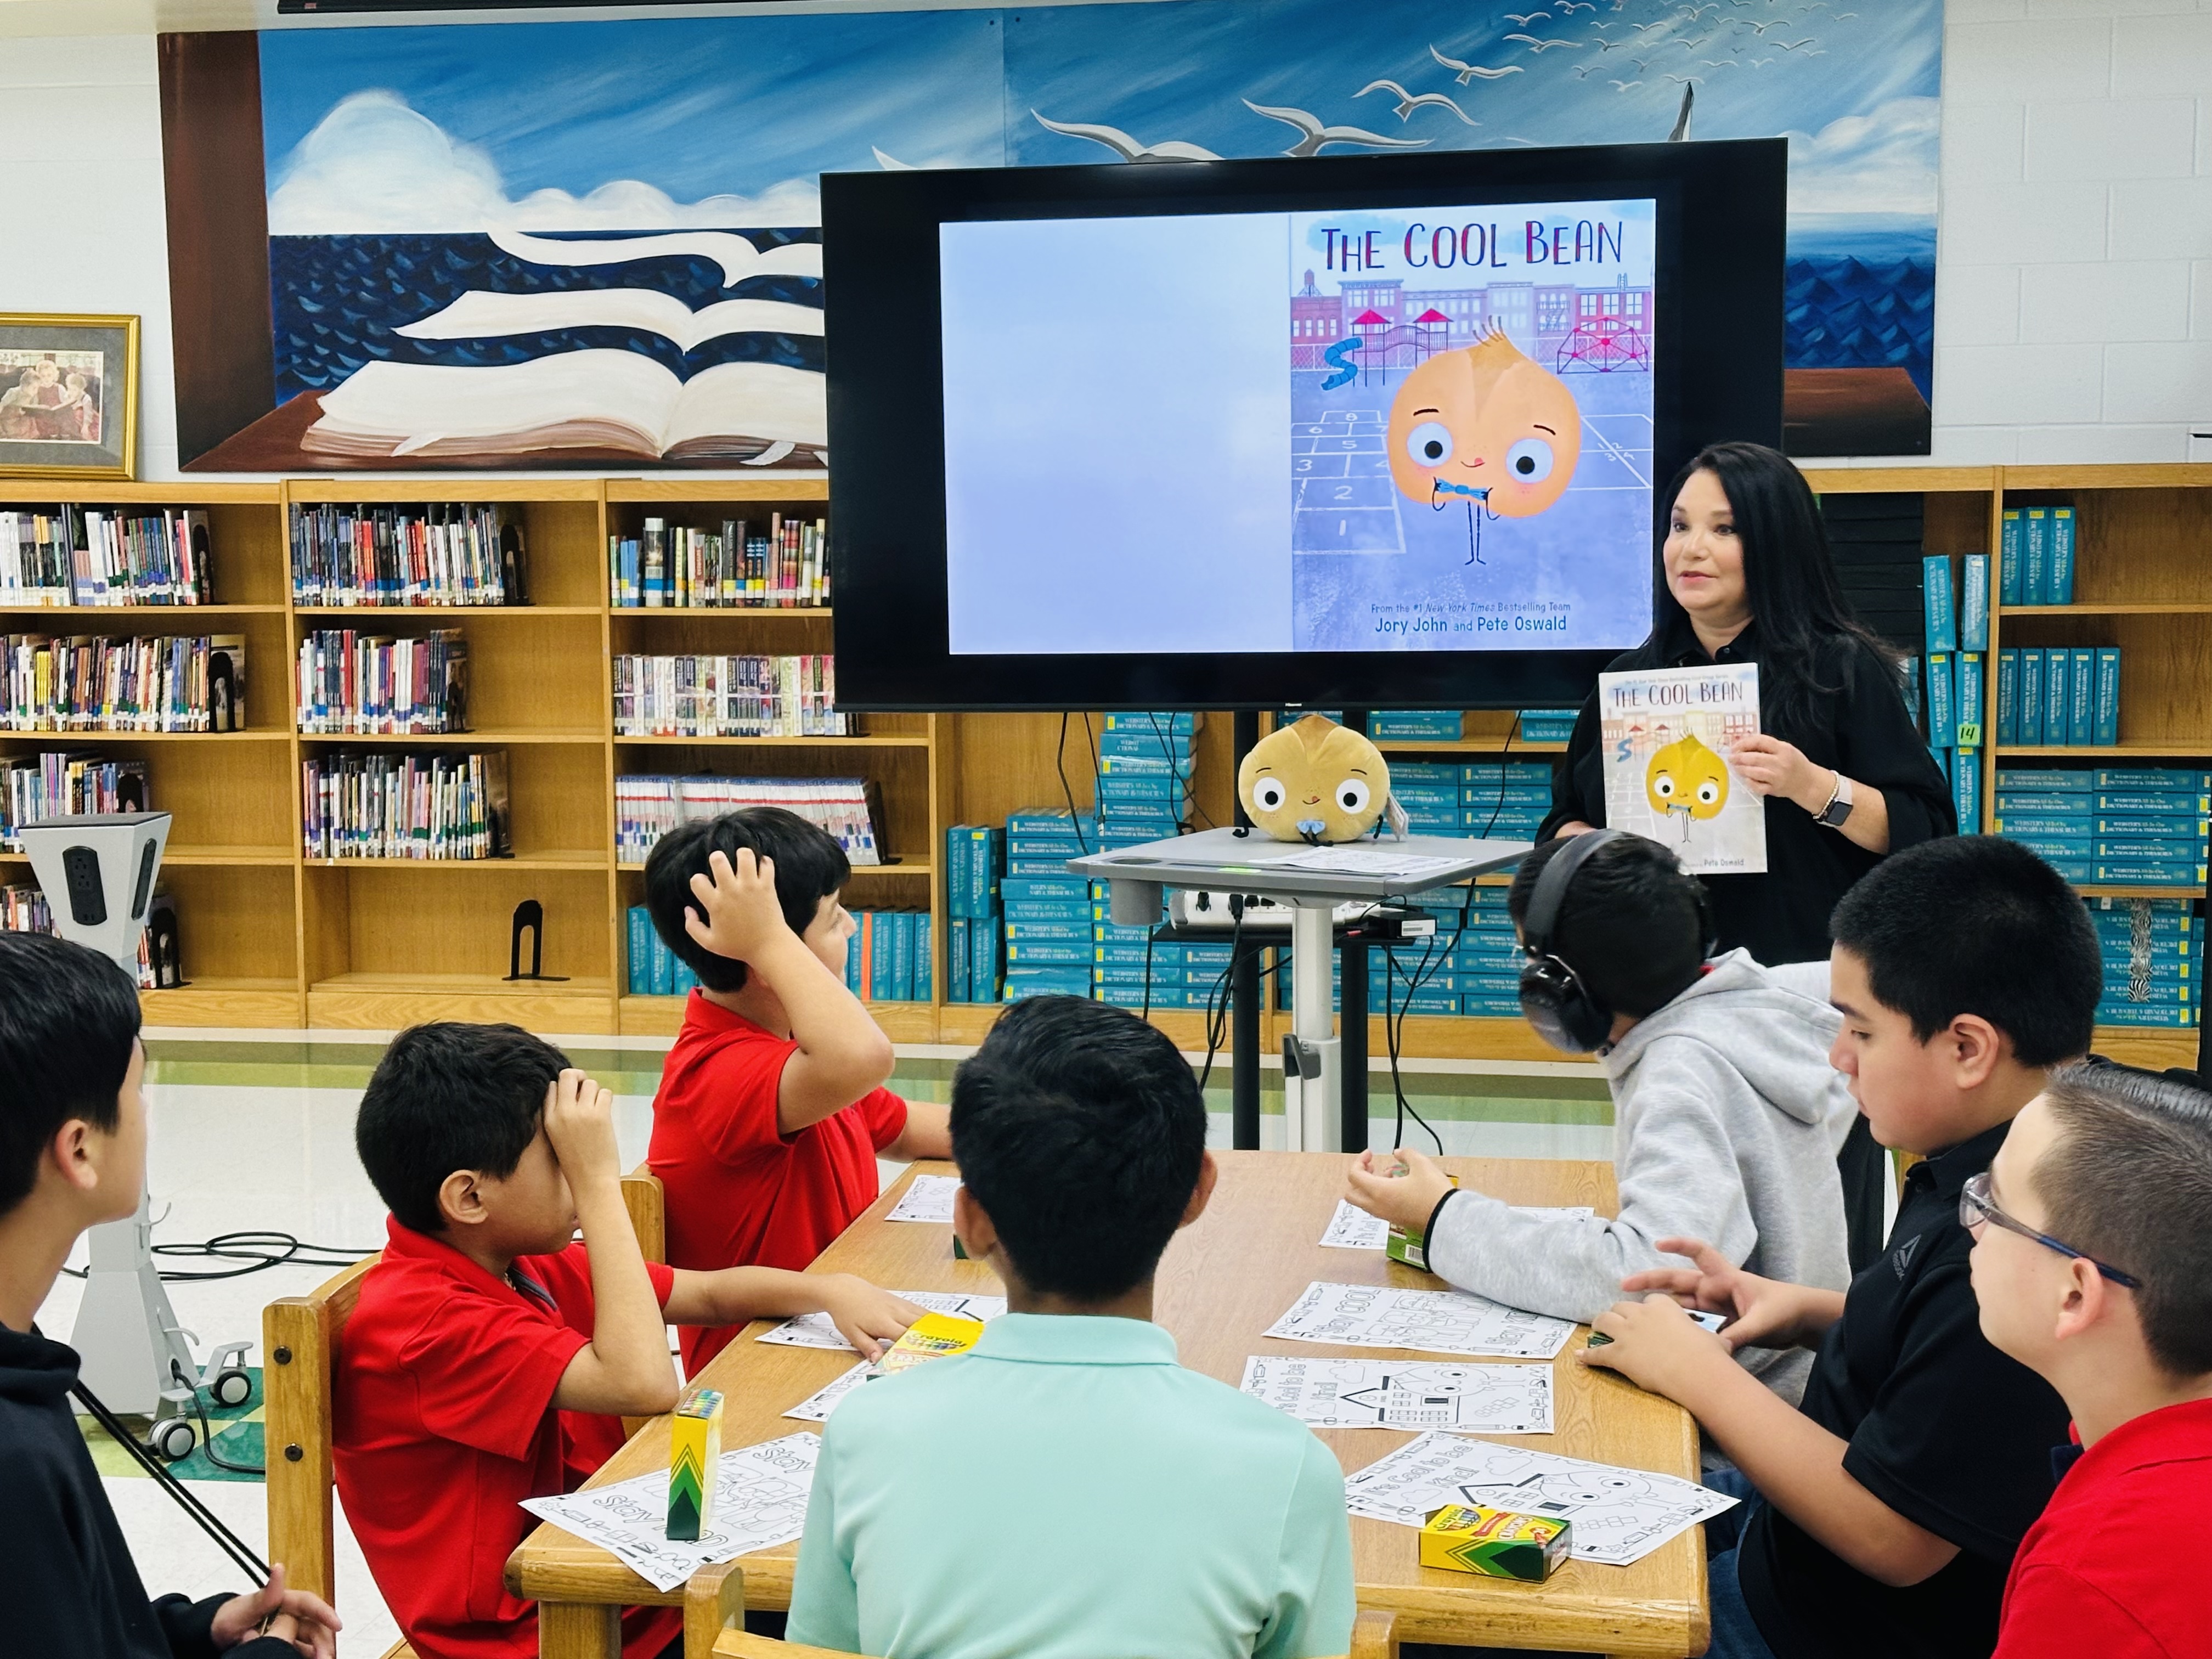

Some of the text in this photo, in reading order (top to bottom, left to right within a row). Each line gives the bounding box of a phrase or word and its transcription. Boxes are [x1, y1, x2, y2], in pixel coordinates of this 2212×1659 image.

[1321, 220, 1622, 272] THE COOL BEAN
[1345, 413, 1358, 421] 8
[1342, 440, 1357, 449] 5
[1296, 459, 1312, 471] 3
[1334, 486, 1352, 500] 2
[1339, 520, 1346, 536] 1
[1372, 602, 1571, 613] From the #1 New York Times Bestselling Team
[1375, 616, 1567, 635] Jory John and Pete Oswald
[1613, 681, 1742, 708] THE COOL BEAN
[1960, 727, 1976, 740] 14
[1313, 1289, 1381, 1334] Stay COOL
[912, 1333, 963, 1345] Crayola
[1485, 1325, 1536, 1346] Stay
[1280, 1364, 1306, 1376] be
[1278, 1377, 1303, 1385] to
[1274, 1386, 1302, 1401] Cool
[753, 1447, 816, 1474] Stay
[1388, 1464, 1435, 1483] Cool
[1420, 1457, 1450, 1468] to
[1435, 1445, 1473, 1458] be
[593, 1495, 664, 1523] Stay
[1434, 1508, 1464, 1531] Crayola
[1497, 1515, 1534, 1539] CRAYONS
